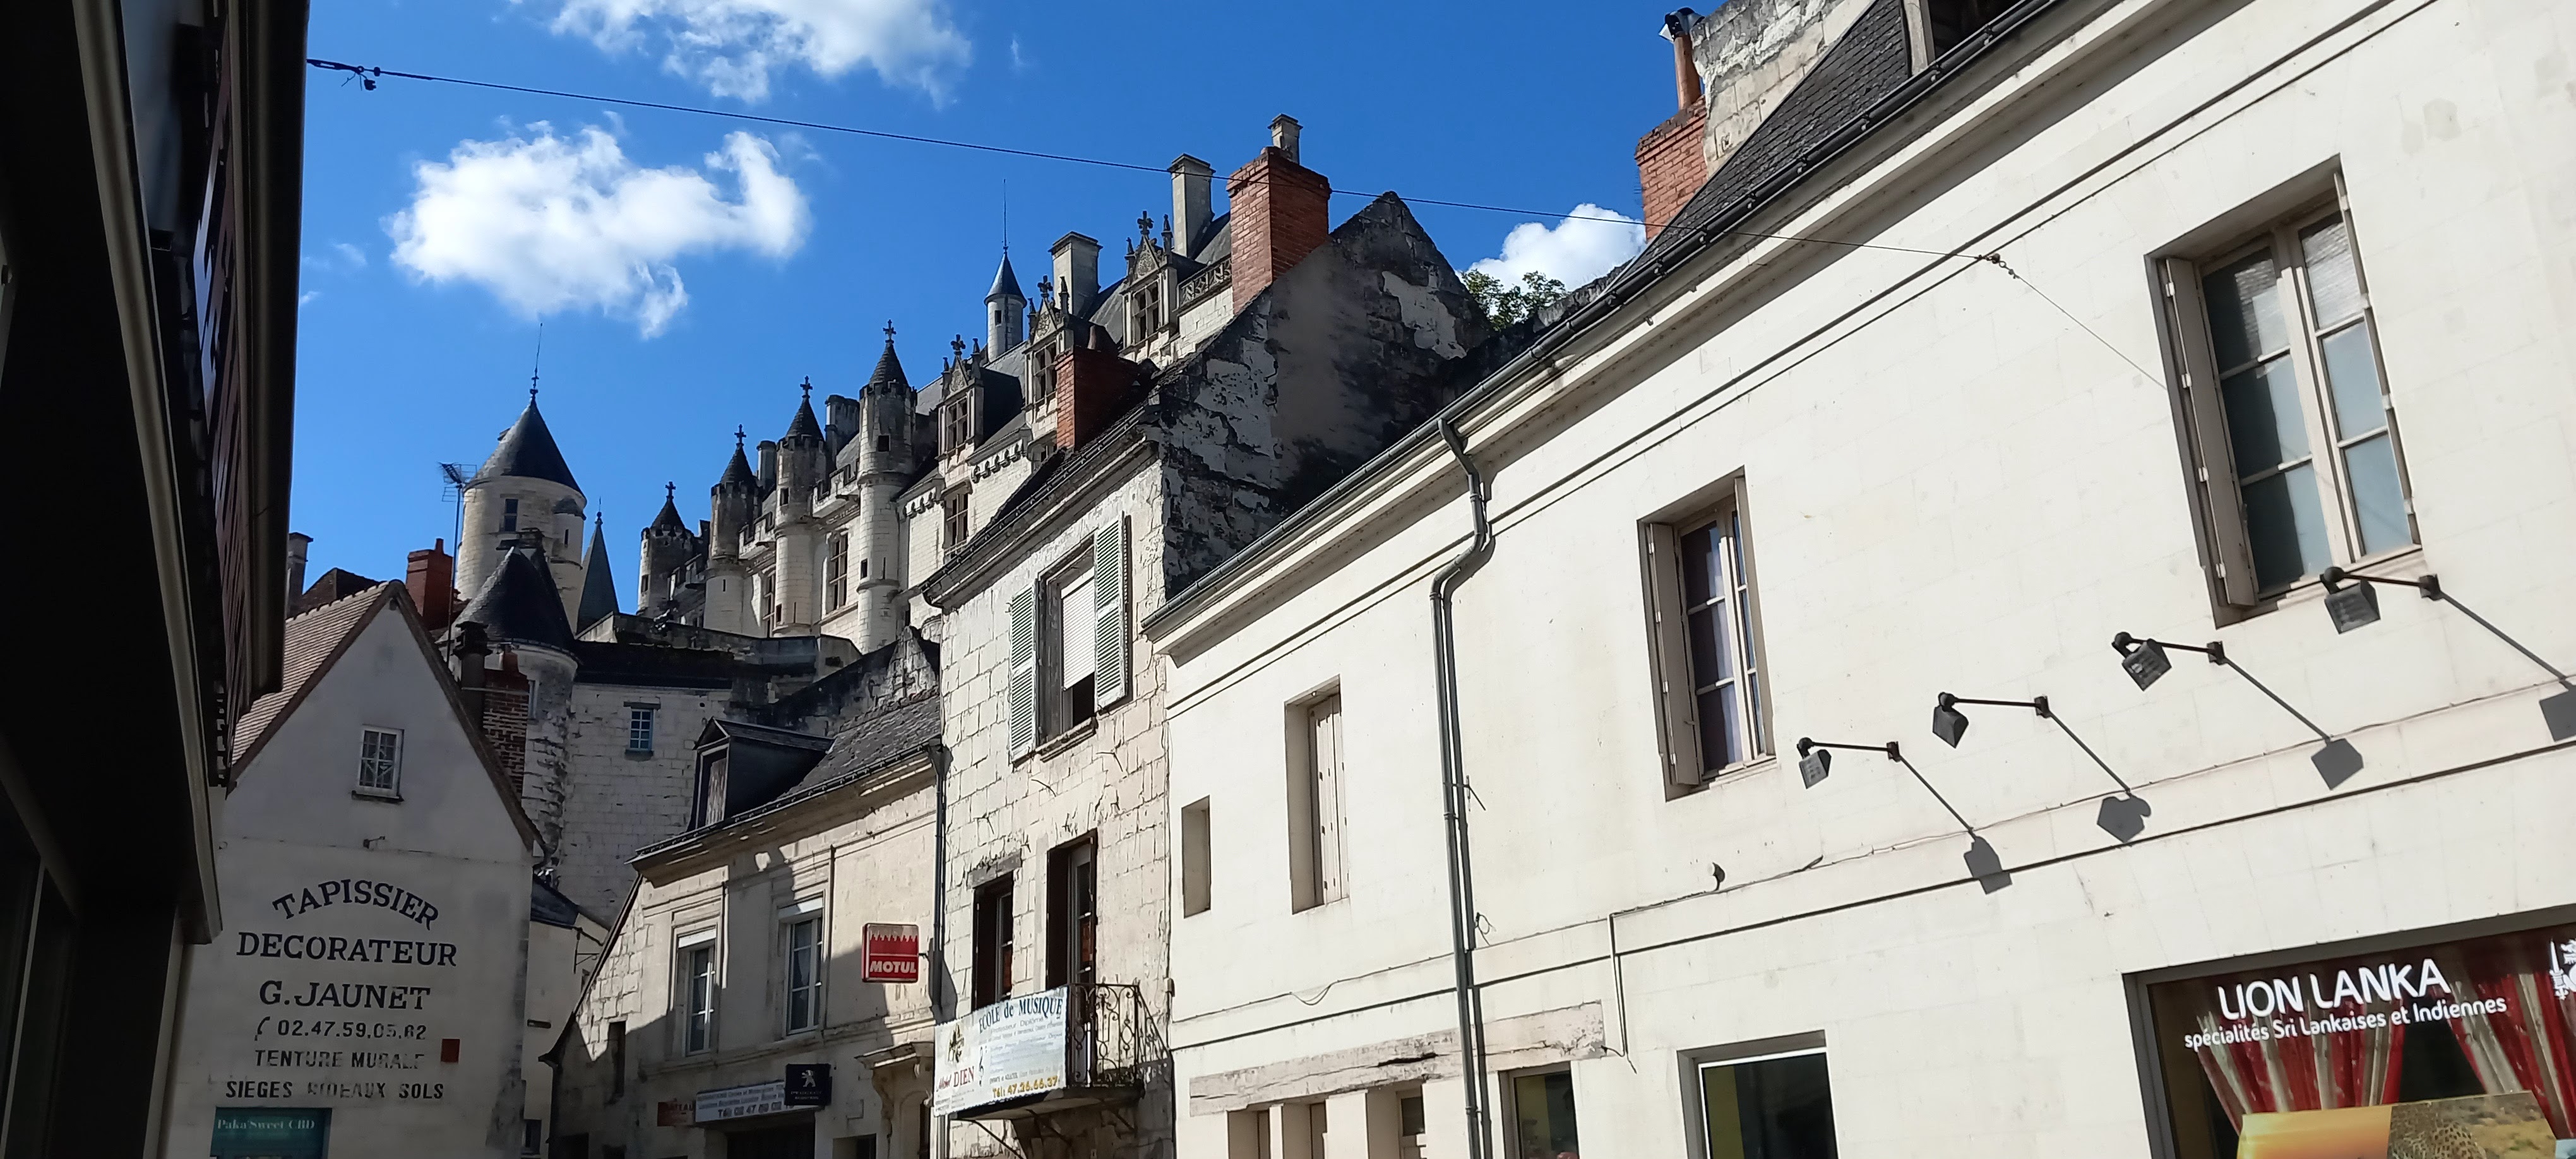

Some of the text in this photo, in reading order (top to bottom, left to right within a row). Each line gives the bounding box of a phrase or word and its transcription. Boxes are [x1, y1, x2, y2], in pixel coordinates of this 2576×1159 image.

[272, 879, 439, 930] TAPISSIER
[236, 930, 457, 966] DECORATEUR
[869, 960, 917, 973] MOTUL
[259, 980, 431, 1010] G.JAUNET
[2217, 958, 2452, 1021] LION LANKA
[979, 996, 1063, 1034] ECOLE de MUSIQUE
[2185, 997, 2507, 1053] spécialités Sri Lankaises et Indiennes
[255, 1049, 343, 1067] TENTURE
[225, 1081, 293, 1098] SIEGES
[398, 1083, 444, 1100] SOLS
[953, 1066, 975, 1087] DIEN
